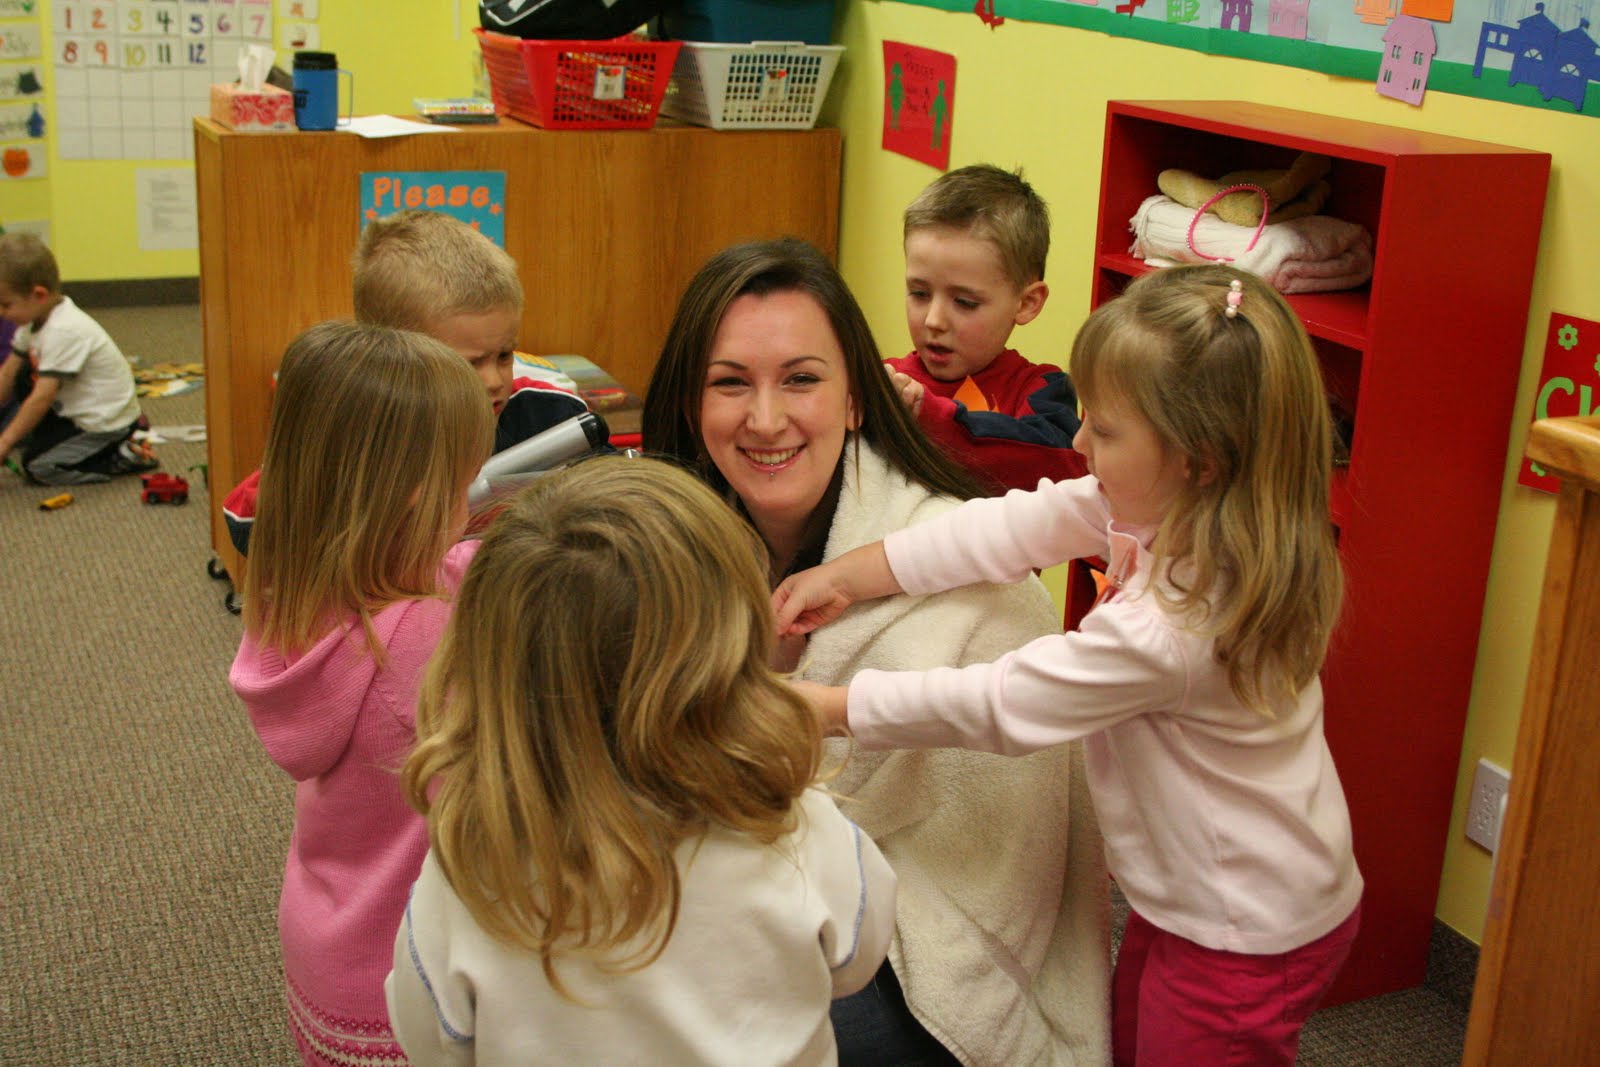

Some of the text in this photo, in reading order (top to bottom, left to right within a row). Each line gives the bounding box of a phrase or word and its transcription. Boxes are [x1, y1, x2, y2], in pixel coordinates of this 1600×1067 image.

[65, 7, 264, 36] 1 2 3 4 5 6 7
[63, 41, 206, 66] 8 9 10 11 12
[374, 177, 490, 208] Please
